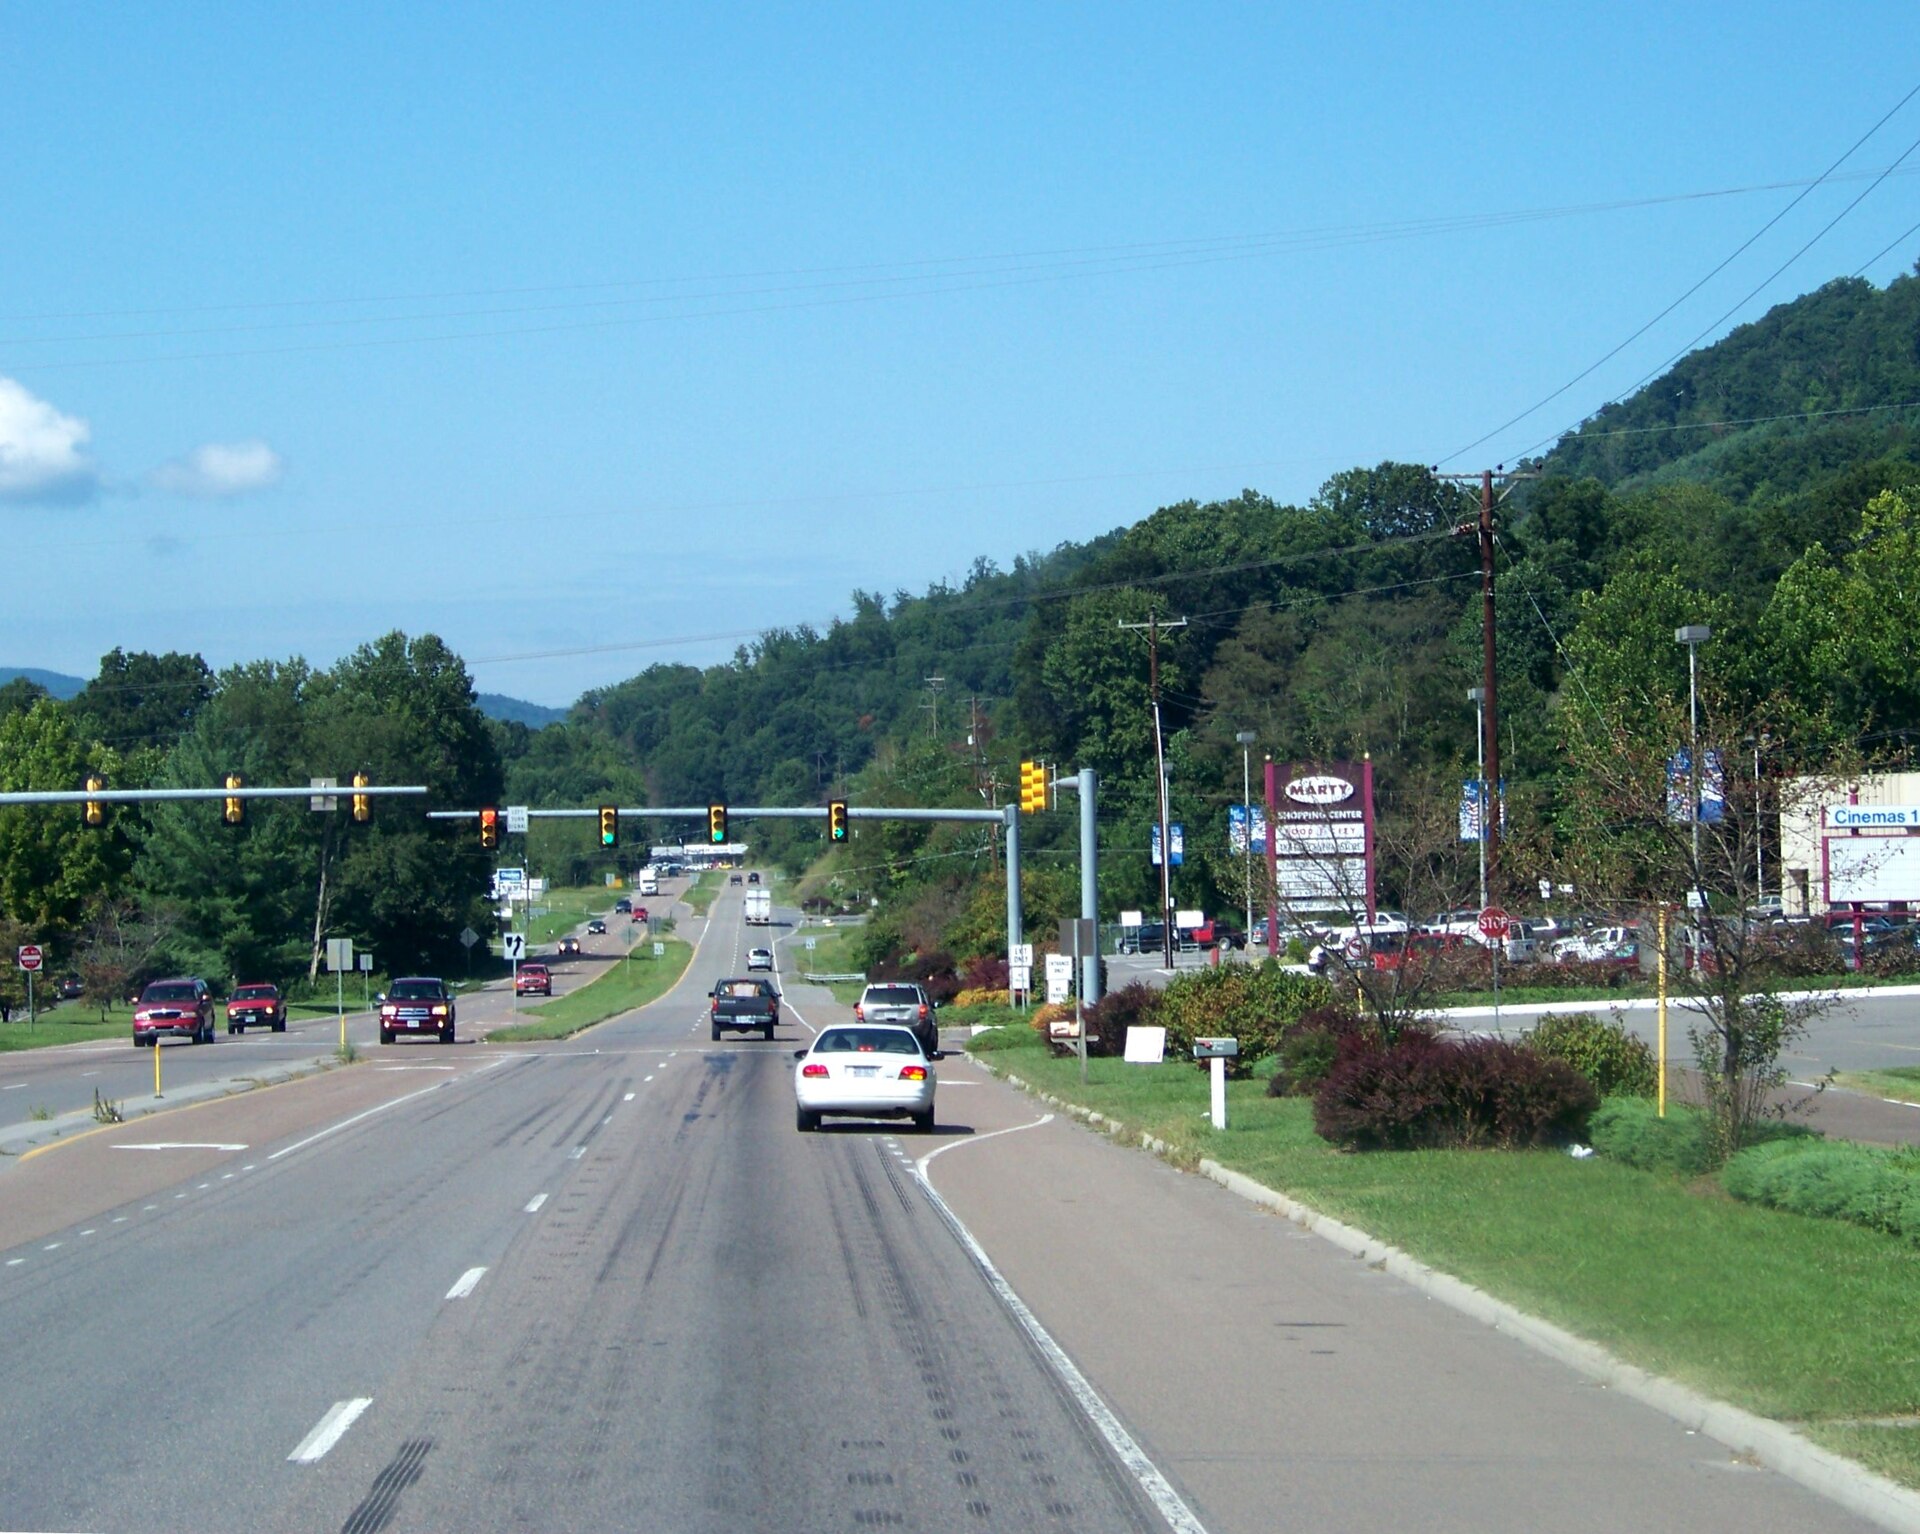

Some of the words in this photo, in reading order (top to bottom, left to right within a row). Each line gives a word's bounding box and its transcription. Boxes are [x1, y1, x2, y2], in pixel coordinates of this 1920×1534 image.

[1289, 784, 1347, 796] MARTY
[1277, 810, 1326, 820] SHOPPING
[1328, 810, 1363, 819] CENTER
[1834, 809, 1906, 824] Cinemas
[1479, 916, 1508, 929] STOP
